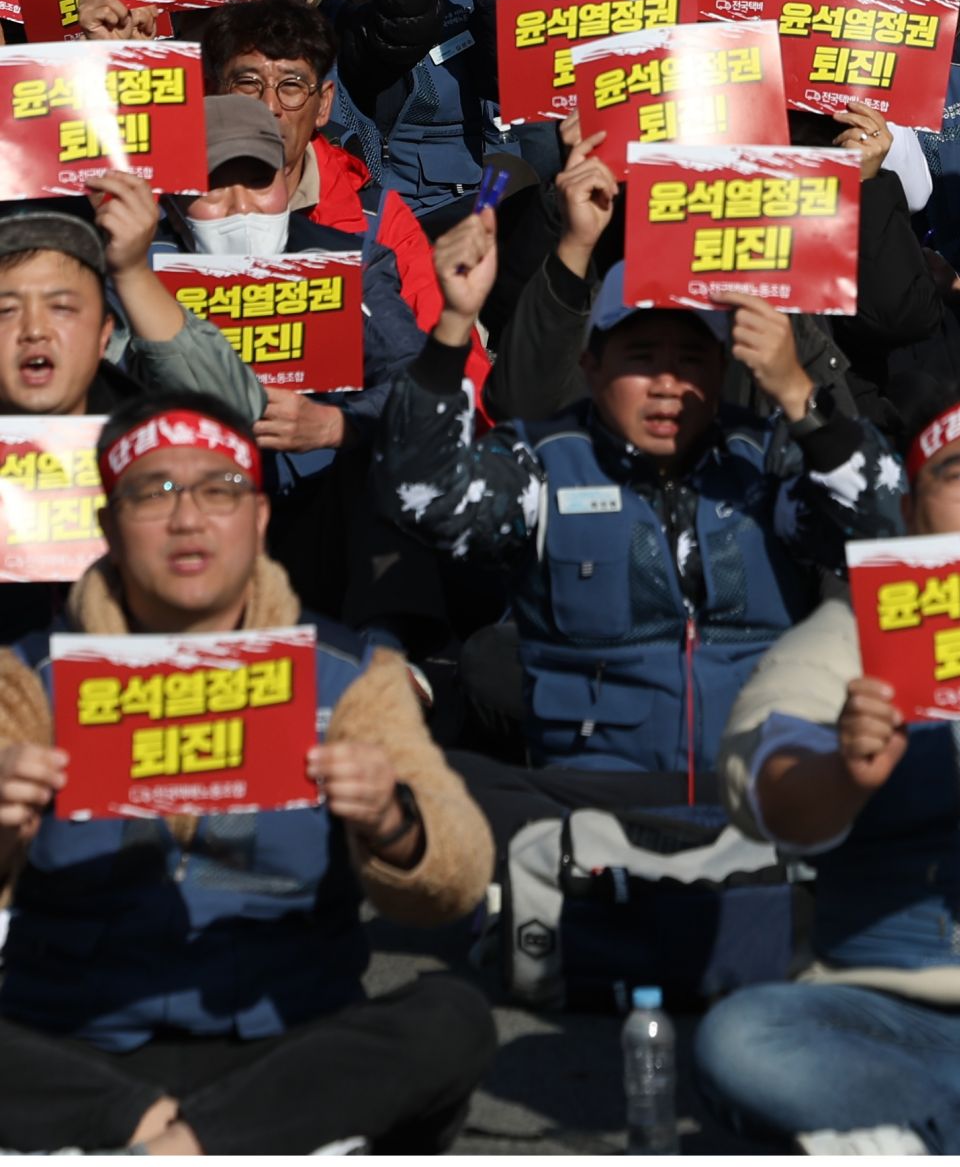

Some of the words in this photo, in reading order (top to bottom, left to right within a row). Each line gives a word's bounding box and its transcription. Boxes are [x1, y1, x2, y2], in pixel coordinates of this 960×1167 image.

[777, 2, 940, 48] 윤석열정권
[808, 46, 897, 88] 퇴진!
[648, 176, 840, 222] 윤석열정권
[690, 226, 793, 272] 퇴진!
[174, 276, 343, 321] 윤석열정권
[218, 322, 304, 364] 퇴진!
[78, 659, 292, 725] 윤석열정권
[130, 719, 244, 778] 퇴진!
